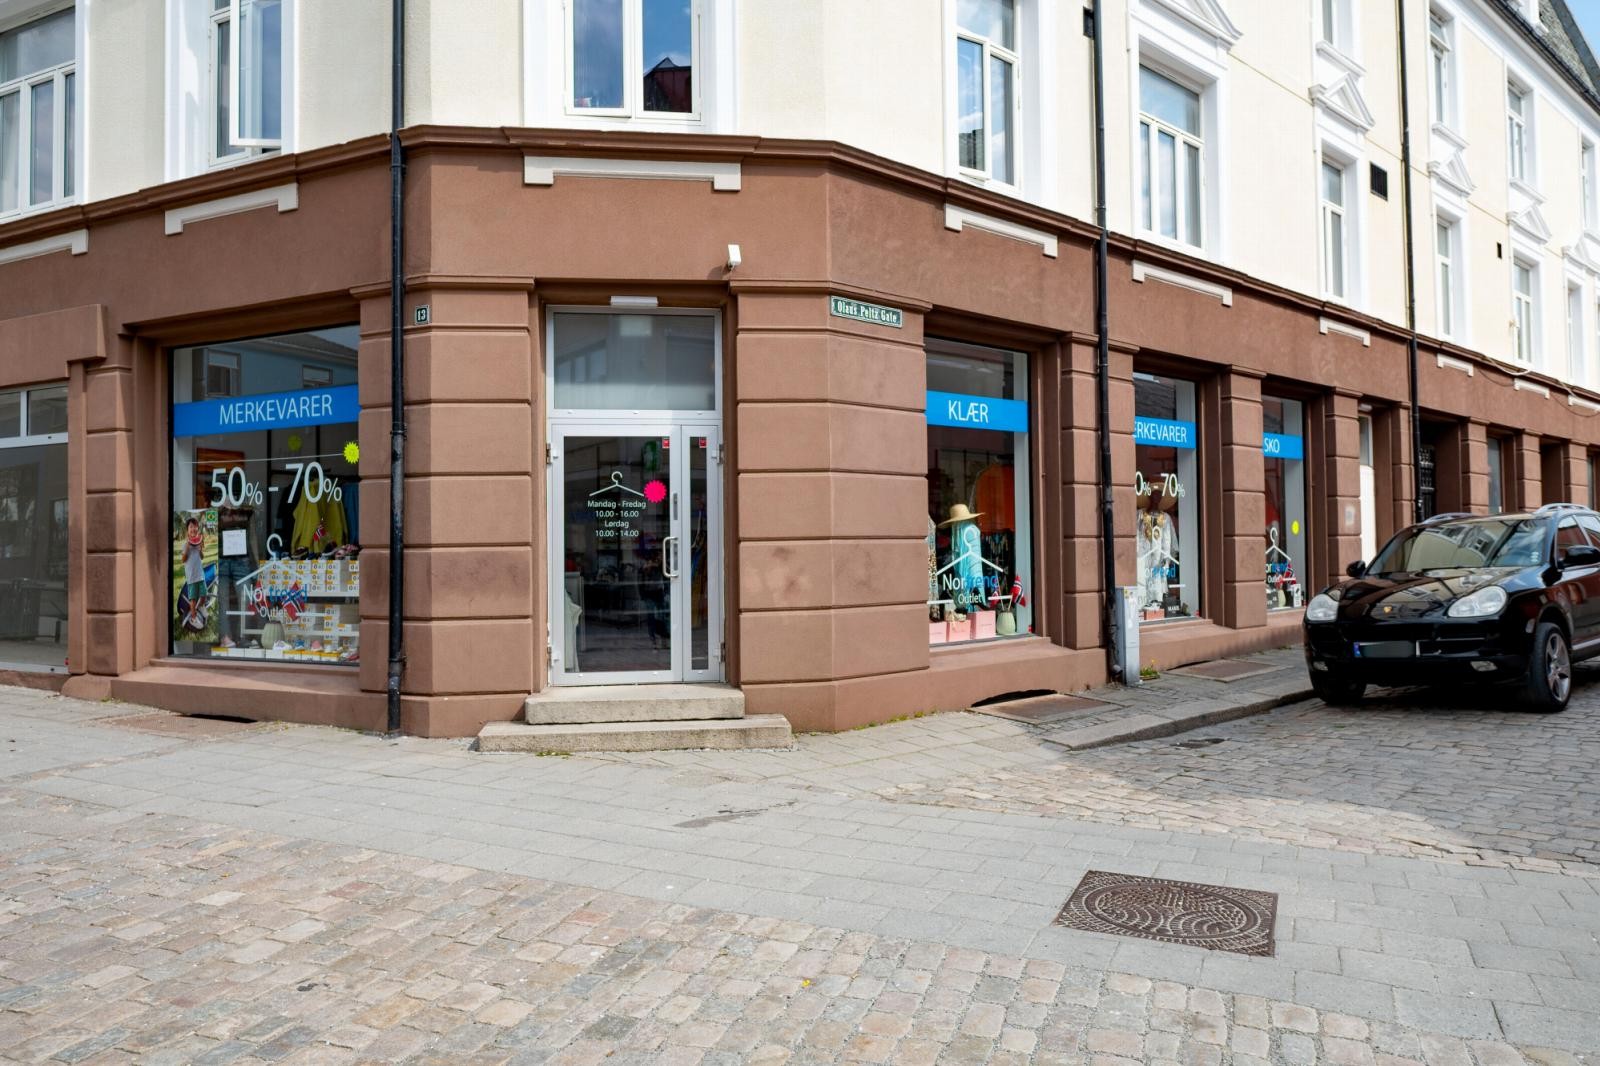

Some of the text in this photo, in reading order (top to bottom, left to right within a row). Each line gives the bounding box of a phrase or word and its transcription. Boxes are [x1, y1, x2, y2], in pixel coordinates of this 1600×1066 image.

[417, 308, 426, 321] 13
[860, 305, 879, 320] Peltz
[880, 309, 897, 323] Gate
[219, 394, 333, 425] MERKEVARER
[948, 399, 989, 424] KLÆR
[1134, 421, 1187, 443] RKEVARER
[1264, 437, 1280, 453] SKO
[210, 466, 263, 507] 50%
[285, 461, 343, 504] 70%
[1135, 470, 1152, 496] 0%
[587, 500, 617, 510] Mandag
[622, 500, 647, 510] Fredag
